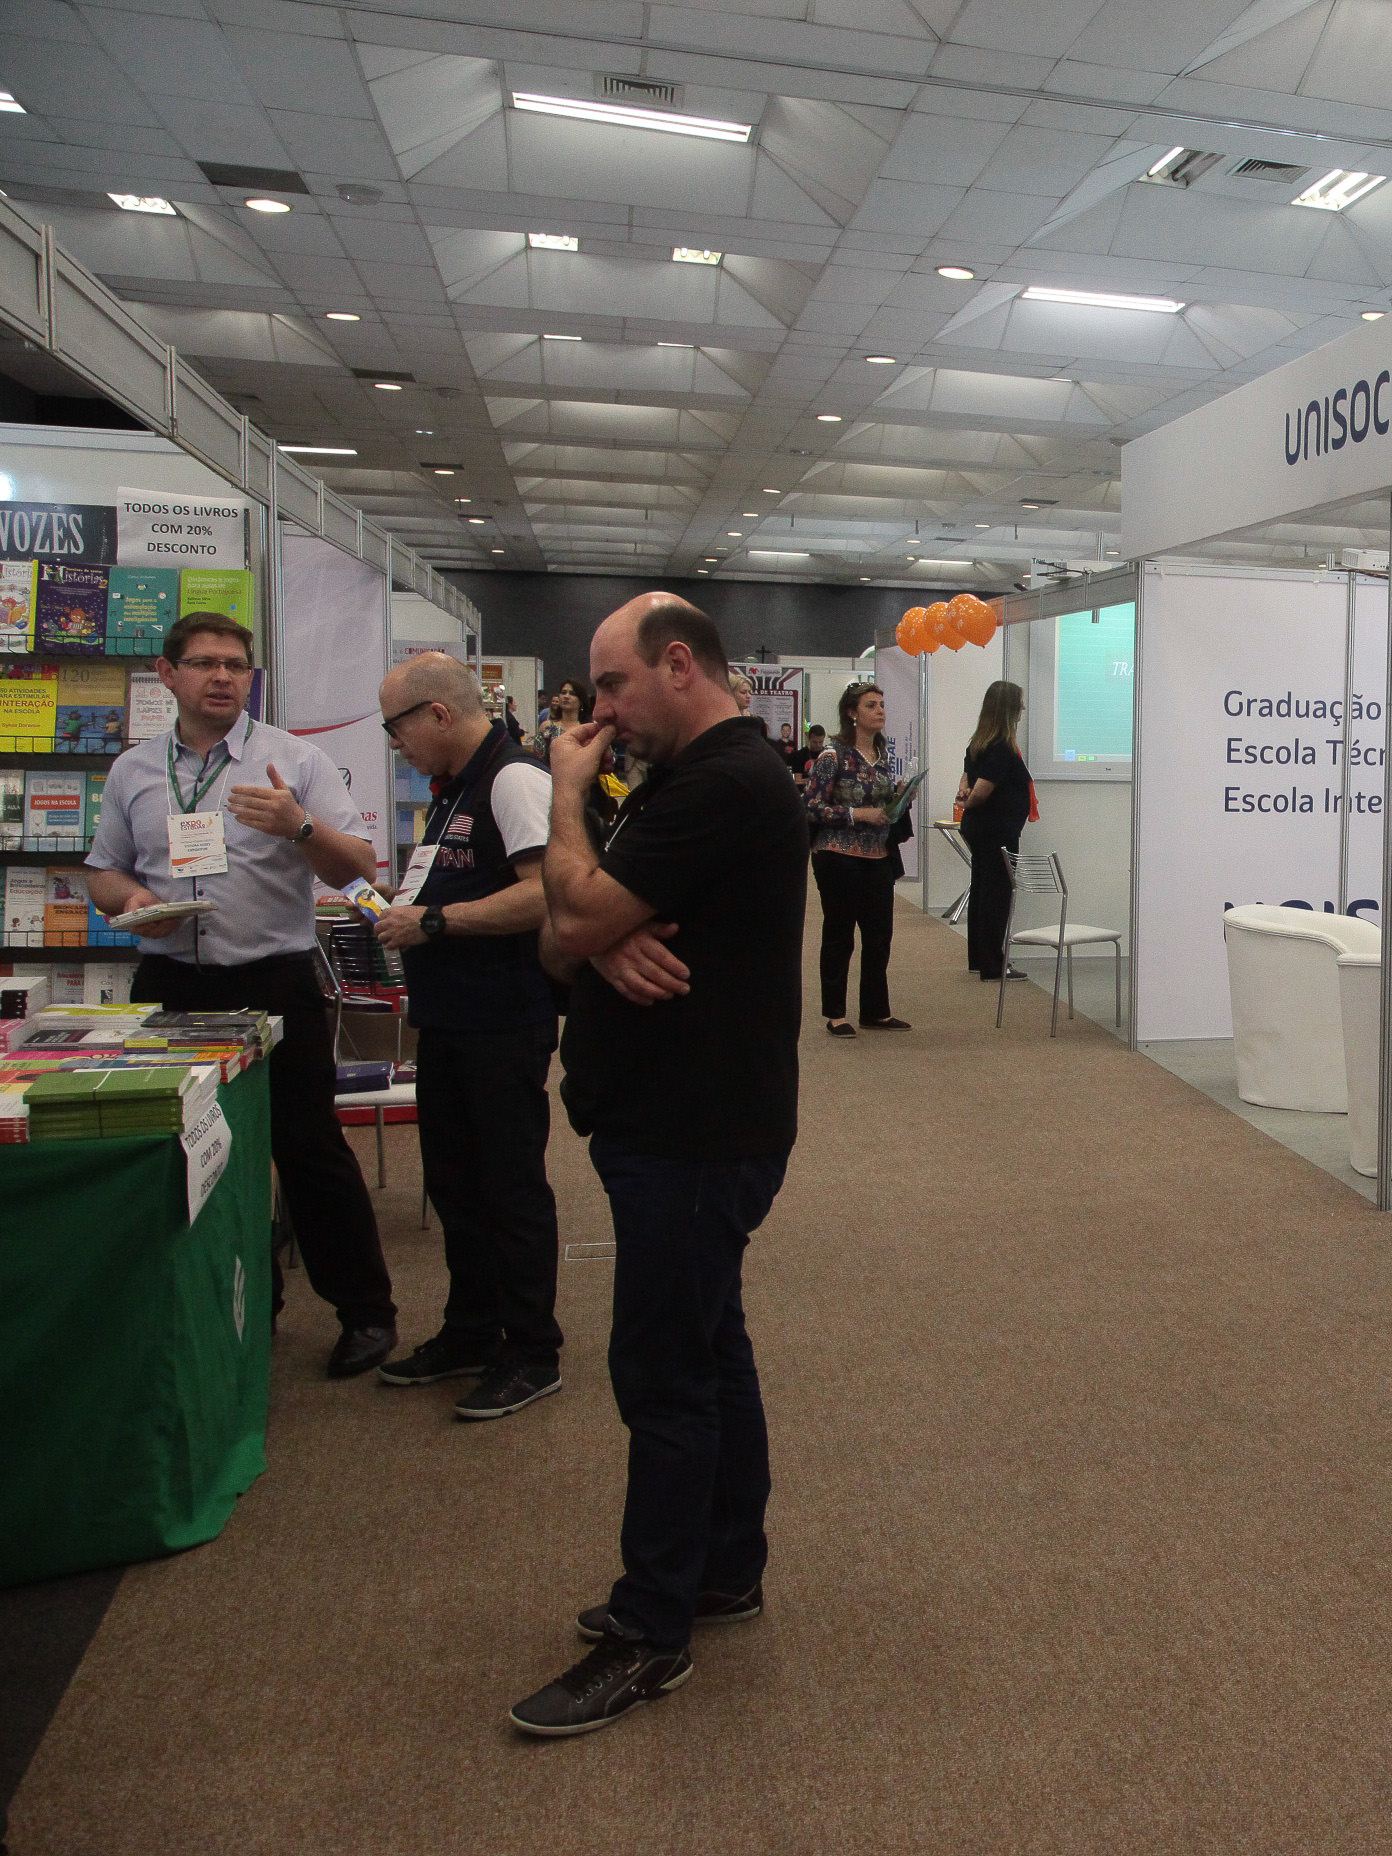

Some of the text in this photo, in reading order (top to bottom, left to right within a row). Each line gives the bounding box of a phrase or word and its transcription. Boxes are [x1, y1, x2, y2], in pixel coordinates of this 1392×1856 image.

[124, 502, 239, 519] TODOS OS LIVROS
[151, 523, 213, 537] COM 20%
[147, 542, 217, 555] DESCONTO
[1223, 690, 1382, 727] Graduação
[1226, 737, 1316, 765] Escola
[1224, 786, 1314, 813] Escola
[184, 1103, 222, 1150] TODOS OS LIVROS
[200, 1146, 213, 1169] COM
